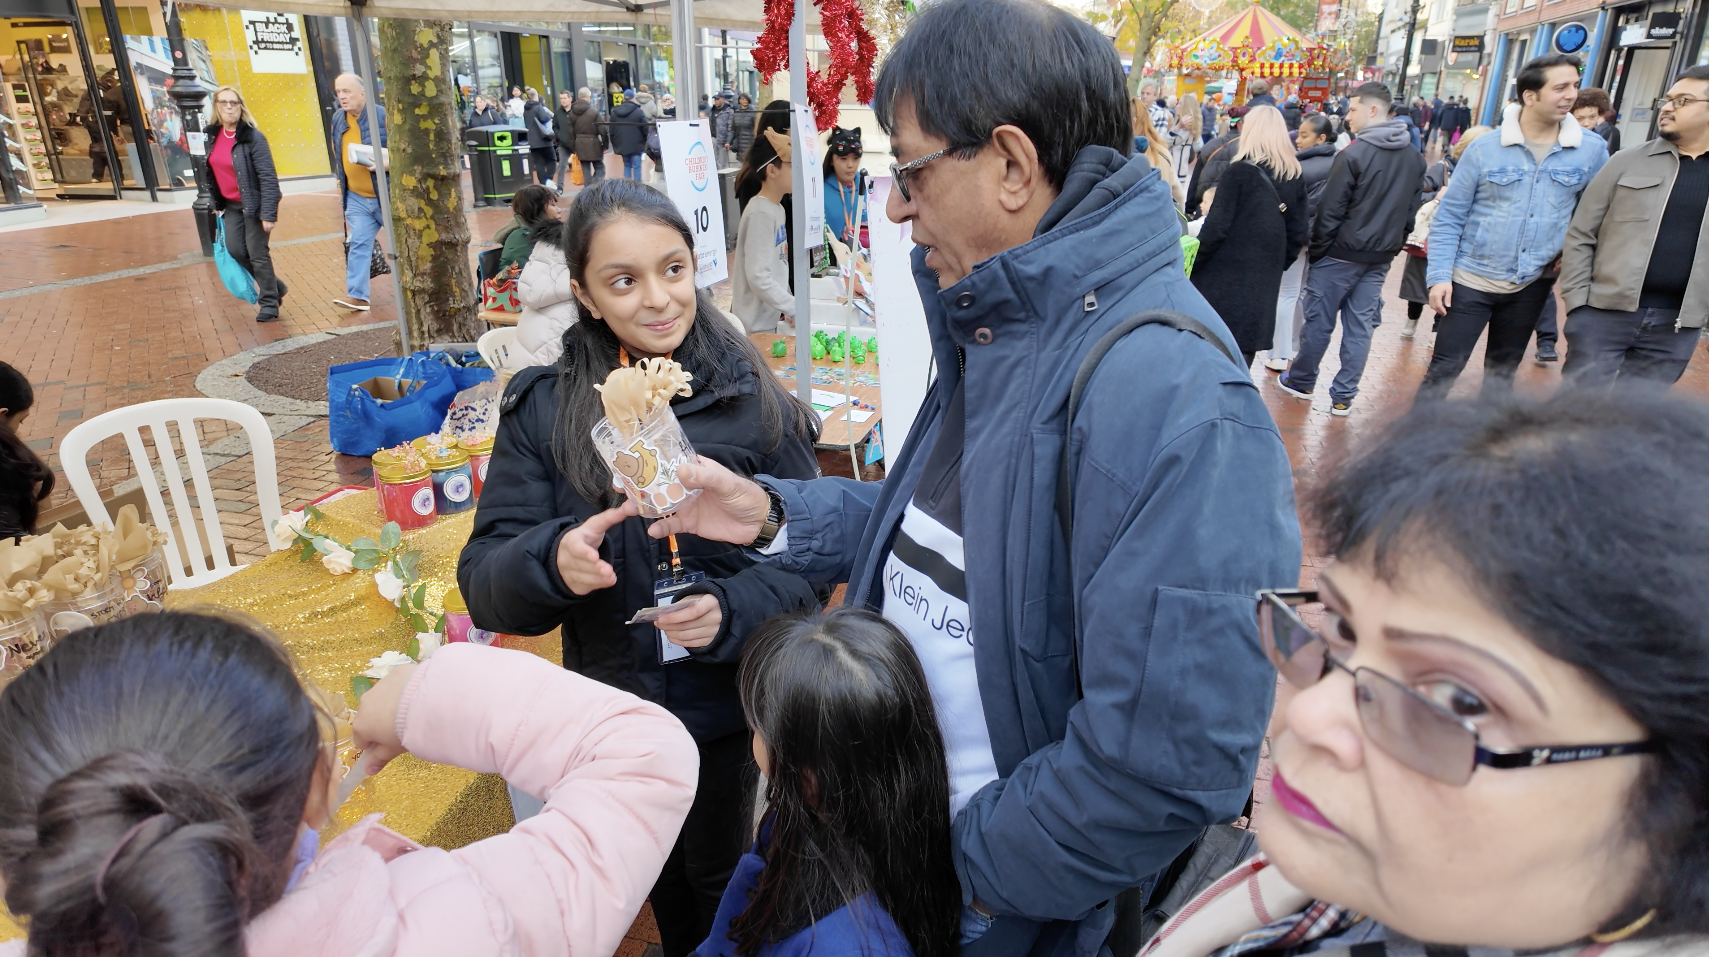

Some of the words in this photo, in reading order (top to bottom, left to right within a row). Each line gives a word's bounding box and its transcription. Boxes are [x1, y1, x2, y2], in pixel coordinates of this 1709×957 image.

[255, 23, 288, 33] BLACK
[257, 32, 290, 42] FRIDAY
[693, 205, 709, 234] 10
[889, 564, 930, 622] Klein
[90, 605, 115, 620] STORM
[8, 630, 46, 659] Never
